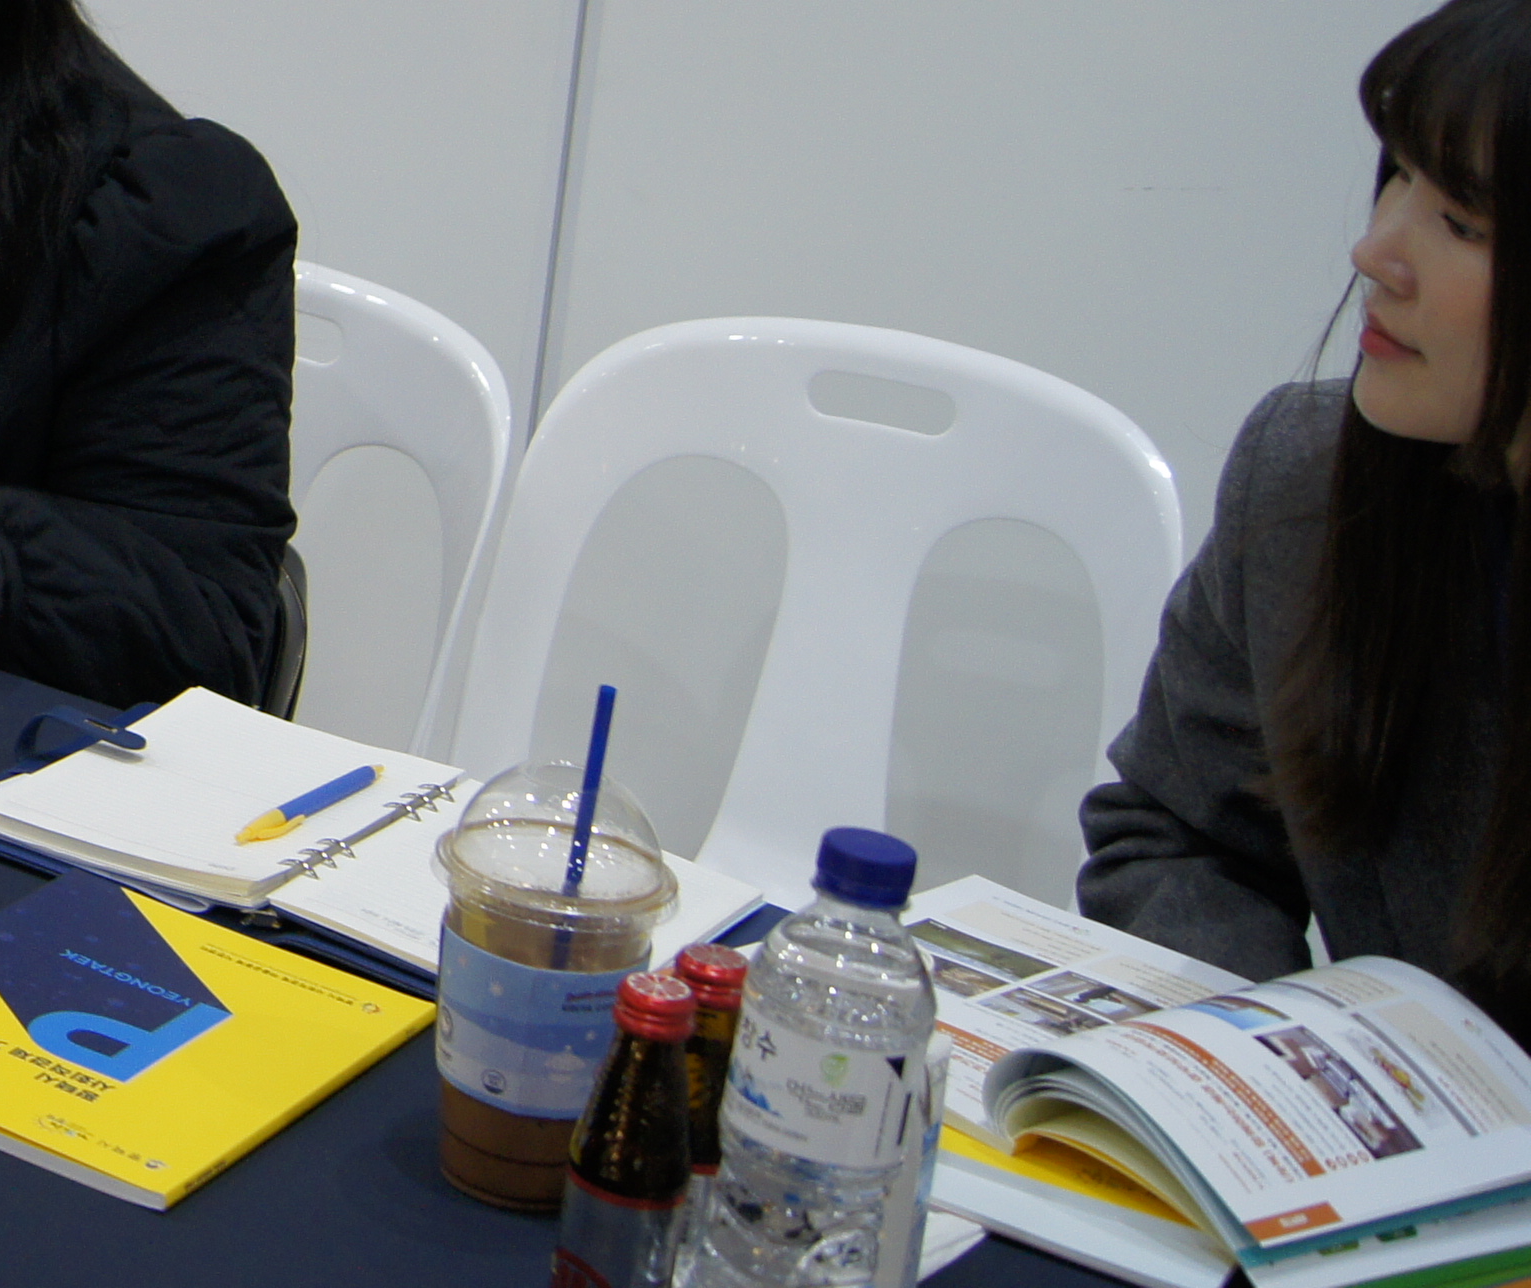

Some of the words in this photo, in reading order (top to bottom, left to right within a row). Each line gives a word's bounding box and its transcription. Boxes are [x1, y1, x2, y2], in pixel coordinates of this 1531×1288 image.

[59, 948, 194, 1007] YEONGTAEK
[7, 1046, 117, 1093] 사회적경제
[33, 1071, 100, 1104] 평택시
